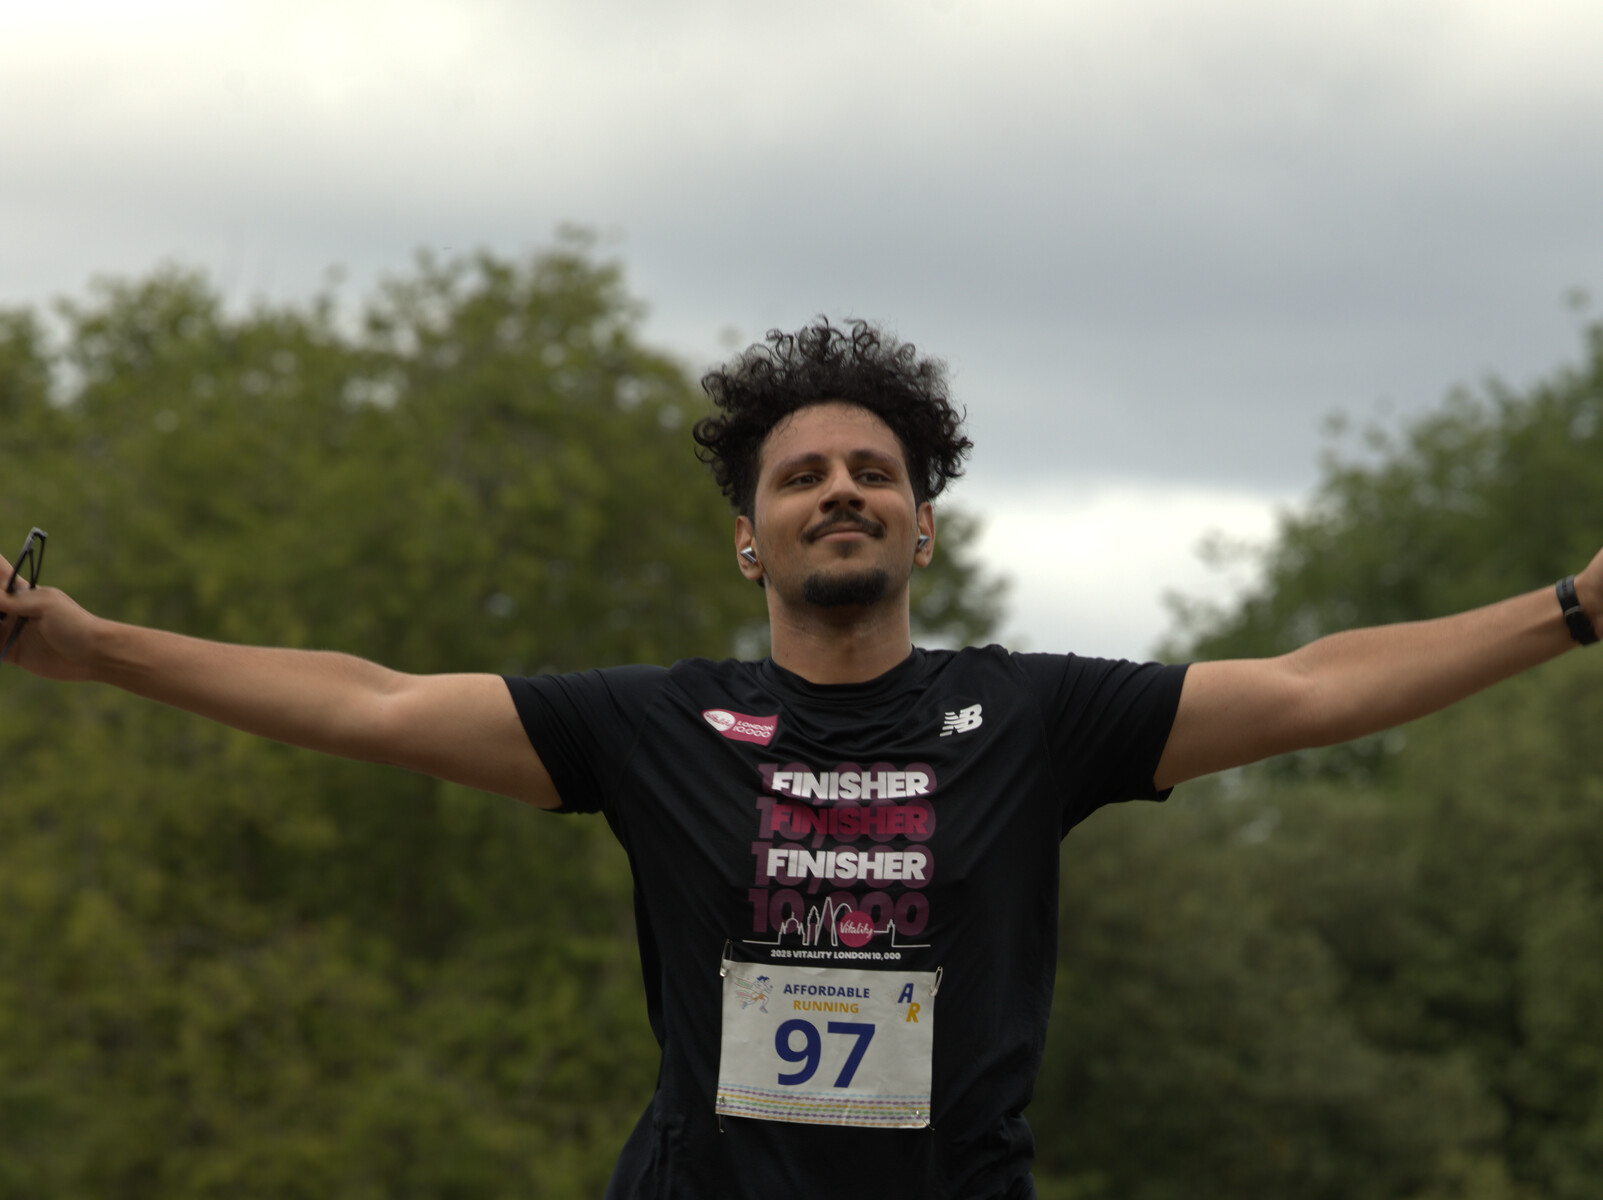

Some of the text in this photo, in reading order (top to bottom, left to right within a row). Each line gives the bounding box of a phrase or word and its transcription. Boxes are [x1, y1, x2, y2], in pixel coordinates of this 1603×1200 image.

[771, 771, 930, 800] FINISHER
[771, 803, 928, 835] FINISHER
[766, 848, 927, 880] FINISHER
[839, 919, 874, 939] Vitality
[770, 949, 901, 961] 2025 VITALITY LONDON 10,000
[783, 984, 870, 999] AFFORDABLE
[793, 1000, 859, 1014] RUNNING
[774, 1018, 876, 1088] 97
